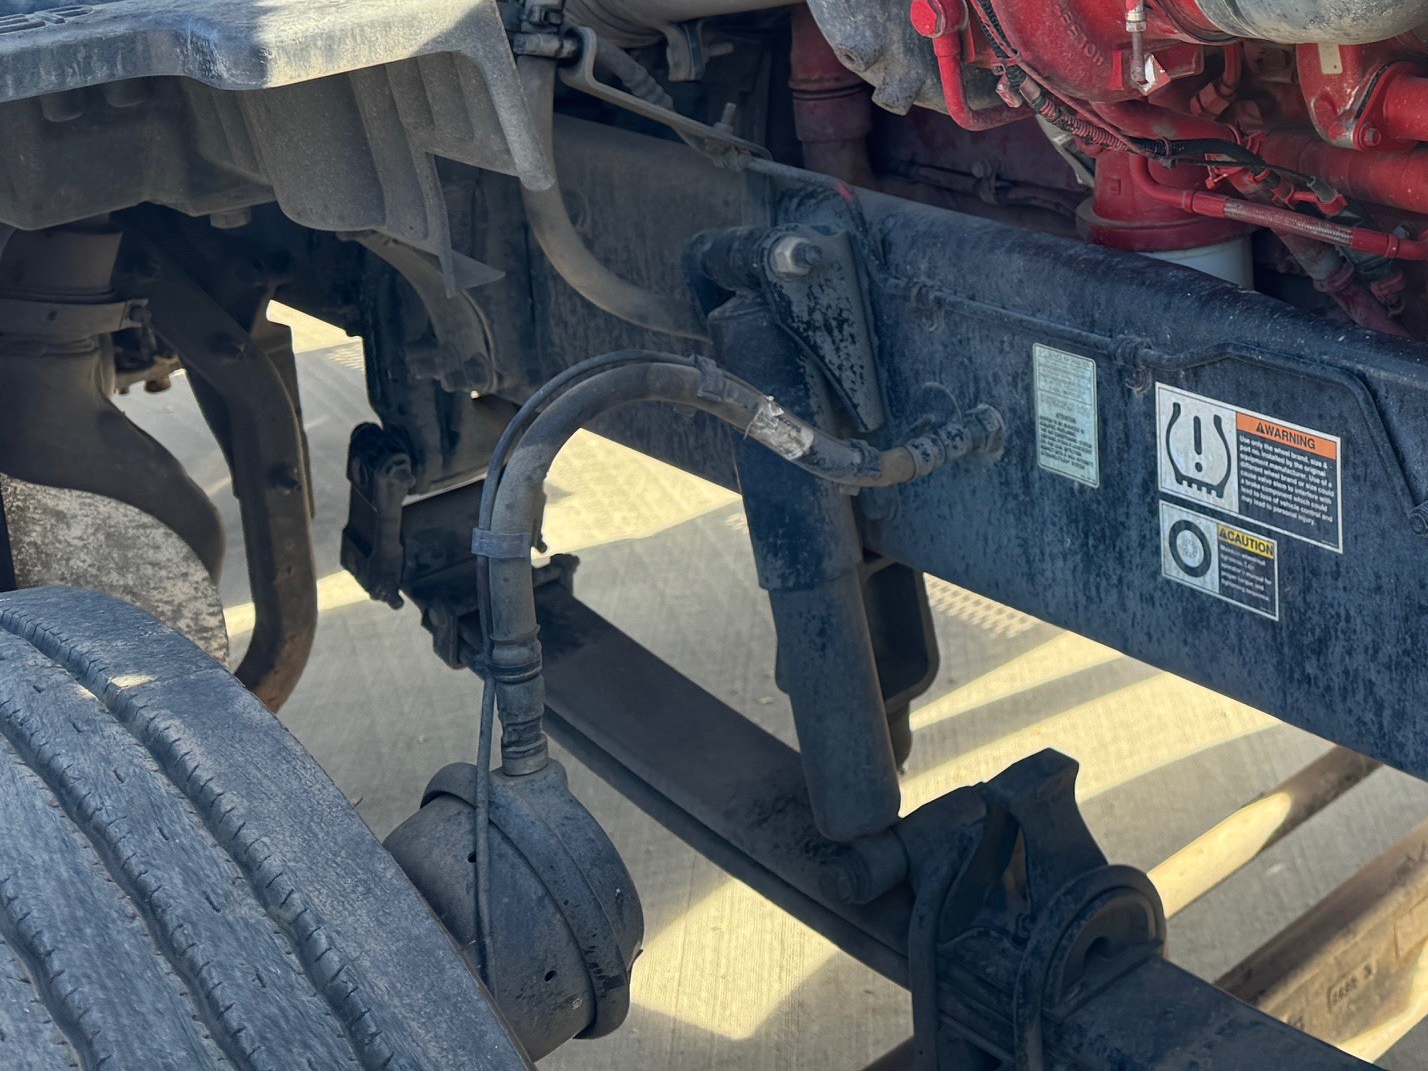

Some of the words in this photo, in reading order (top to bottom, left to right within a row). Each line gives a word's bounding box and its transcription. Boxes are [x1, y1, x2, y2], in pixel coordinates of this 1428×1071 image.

[1239, 435, 1249, 443] Use
[1250, 439, 1262, 448] only
[1263, 443, 1272, 451] the
[1274, 447, 1290, 456] wheel
[1310, 458, 1321, 467] size
[1265, 425, 1315, 449] WARNING
[1239, 444, 1250, 453] part
[1261, 451, 1284, 463] installed
[1286, 458, 1292, 467] by
[1294, 461, 1302, 469] the
[1304, 465, 1325, 477] original
[1240, 453, 1268, 467] equipment
[1308, 475, 1319, 483] Use
[1321, 478, 1326, 486] of
[1240, 461, 1262, 473] different
[1264, 468, 1279, 478] wheel
[1280, 474, 1296, 484] brand
[1305, 483, 1316, 491] size
[1318, 487, 1334, 497] could
[1240, 470, 1256, 479] cause
[1257, 475, 1271, 484] valve
[1273, 480, 1286, 489] stem
[1294, 487, 1317, 500] interfere
[1319, 495, 1331, 504] with
[1245, 479, 1260, 489] brake
[1261, 485, 1292, 500] component
[1293, 495, 1309, 506] which
[1311, 500, 1327, 512] could
[1241, 486, 1252, 494] lead
[1260, 492, 1271, 501] loss
[1272, 496, 1278, 504] of
[1280, 498, 1299, 511] vehicle
[1300, 506, 1320, 518] control
[1321, 513, 1332, 522] and
[1241, 494, 1252, 504] may
[1253, 498, 1265, 507] lead
[1273, 505, 1297, 520] personal
[1227, 530, 1272, 555] CAUTION
